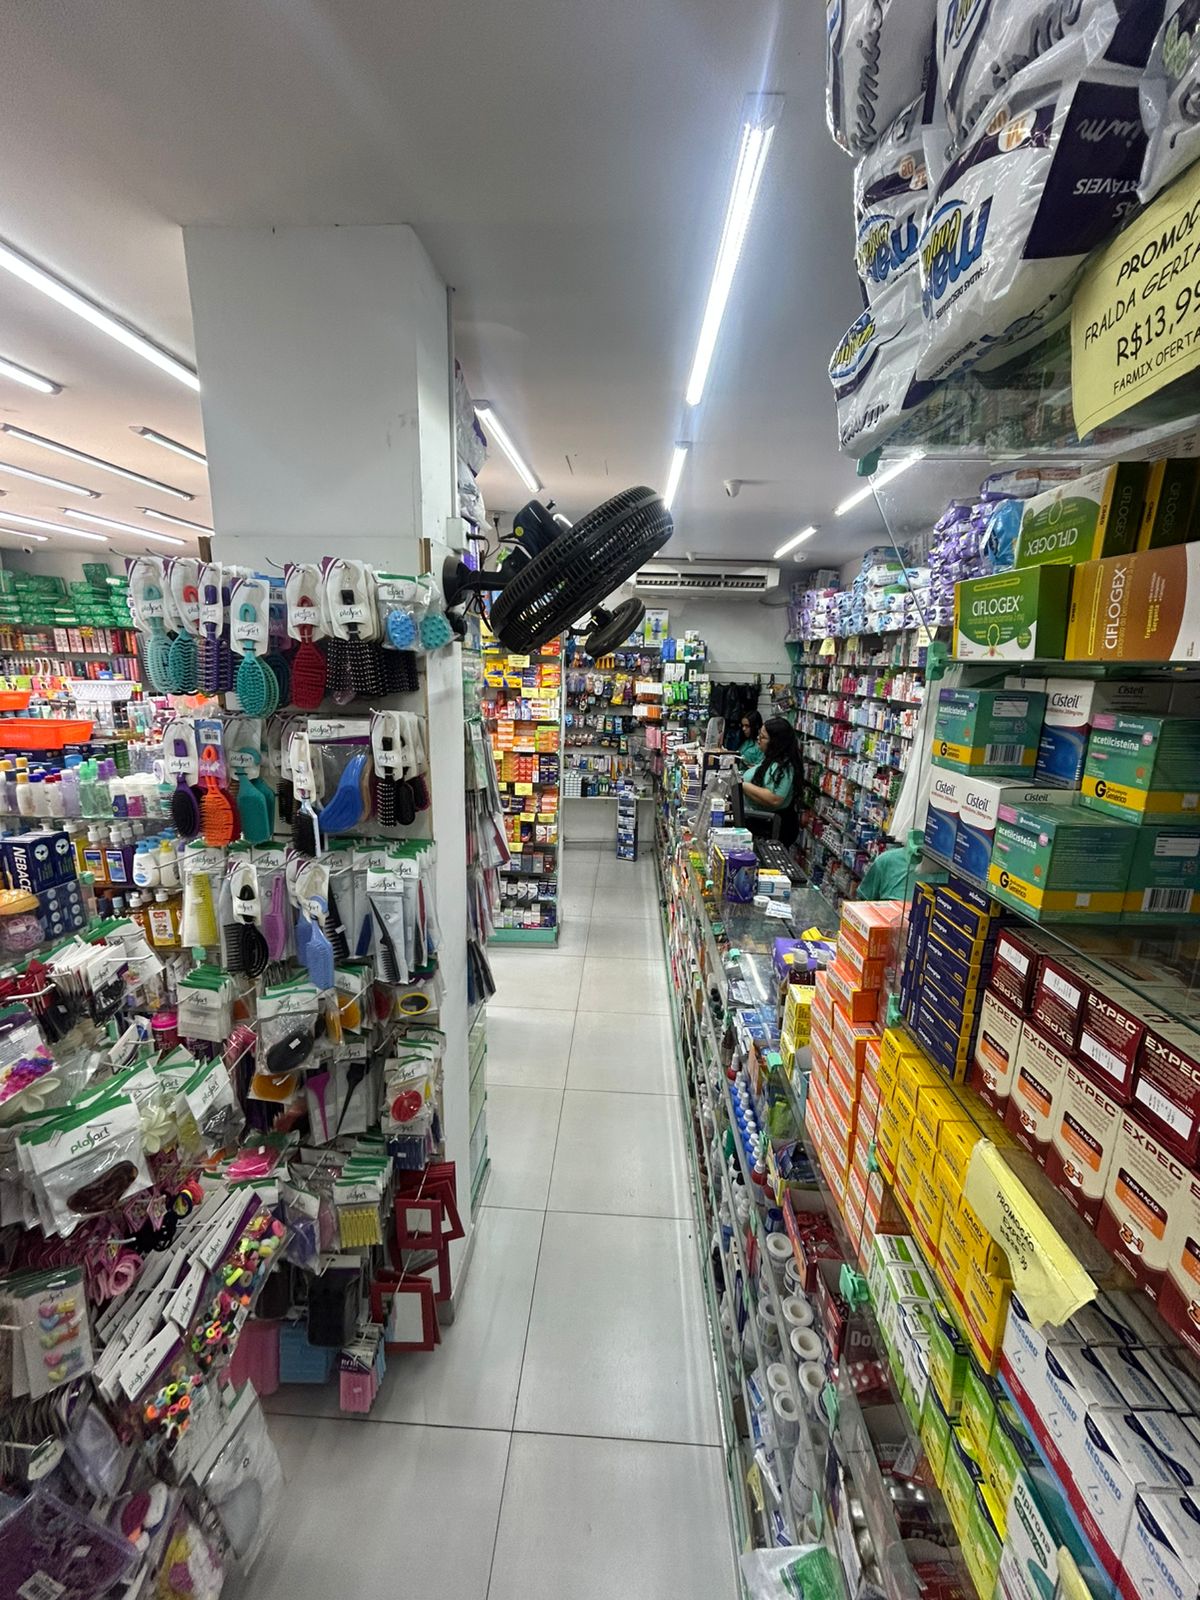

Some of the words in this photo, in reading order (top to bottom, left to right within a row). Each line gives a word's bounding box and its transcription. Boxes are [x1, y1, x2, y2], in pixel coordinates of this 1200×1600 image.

[1085, 288, 1136, 350] FRALDA
[1113, 358, 1153, 395] FARMIX
[1024, 527, 1079, 556] CIFLOGEX
[972, 595, 1020, 617] CIFLOGEX
[1104, 567, 1128, 650] CIFLOGEX
[1052, 692, 1080, 709] Cisteil
[1119, 685, 1145, 695] Cisteil
[941, 742, 948, 756] G
[935, 779, 956, 797] Cisteil
[966, 793, 990, 812] Cisteil
[1024, 793, 1049, 802] Cisteil
[1095, 780, 1107, 798] G
[1000, 871, 1009, 889] G
[992, 976, 1023, 1009] EXPEC
[985, 994, 1018, 1029] EXPEC
[1036, 1009, 1074, 1046] EXPEC
[1088, 993, 1137, 1035] EXPEC
[1023, 1027, 1063, 1068] EXPEC
[1145, 1035, 1200, 1086] EXPEC
[1067, 1068, 1117, 1118] EXPEC
[1122, 1118, 1183, 1182] EXPEC
[1125, 1177, 1144, 1198] TRIPLA
[1143, 1195, 1159, 1213] AÇÃO
[1011, 1313, 1039, 1358] NEOSORO
[1046, 1369, 1078, 1422] NEOSORO
[1085, 1437, 1123, 1501] NEOSORO
[1017, 1484, 1051, 1555] dipirona
[1137, 1522, 1184, 1600] NEOSORO
